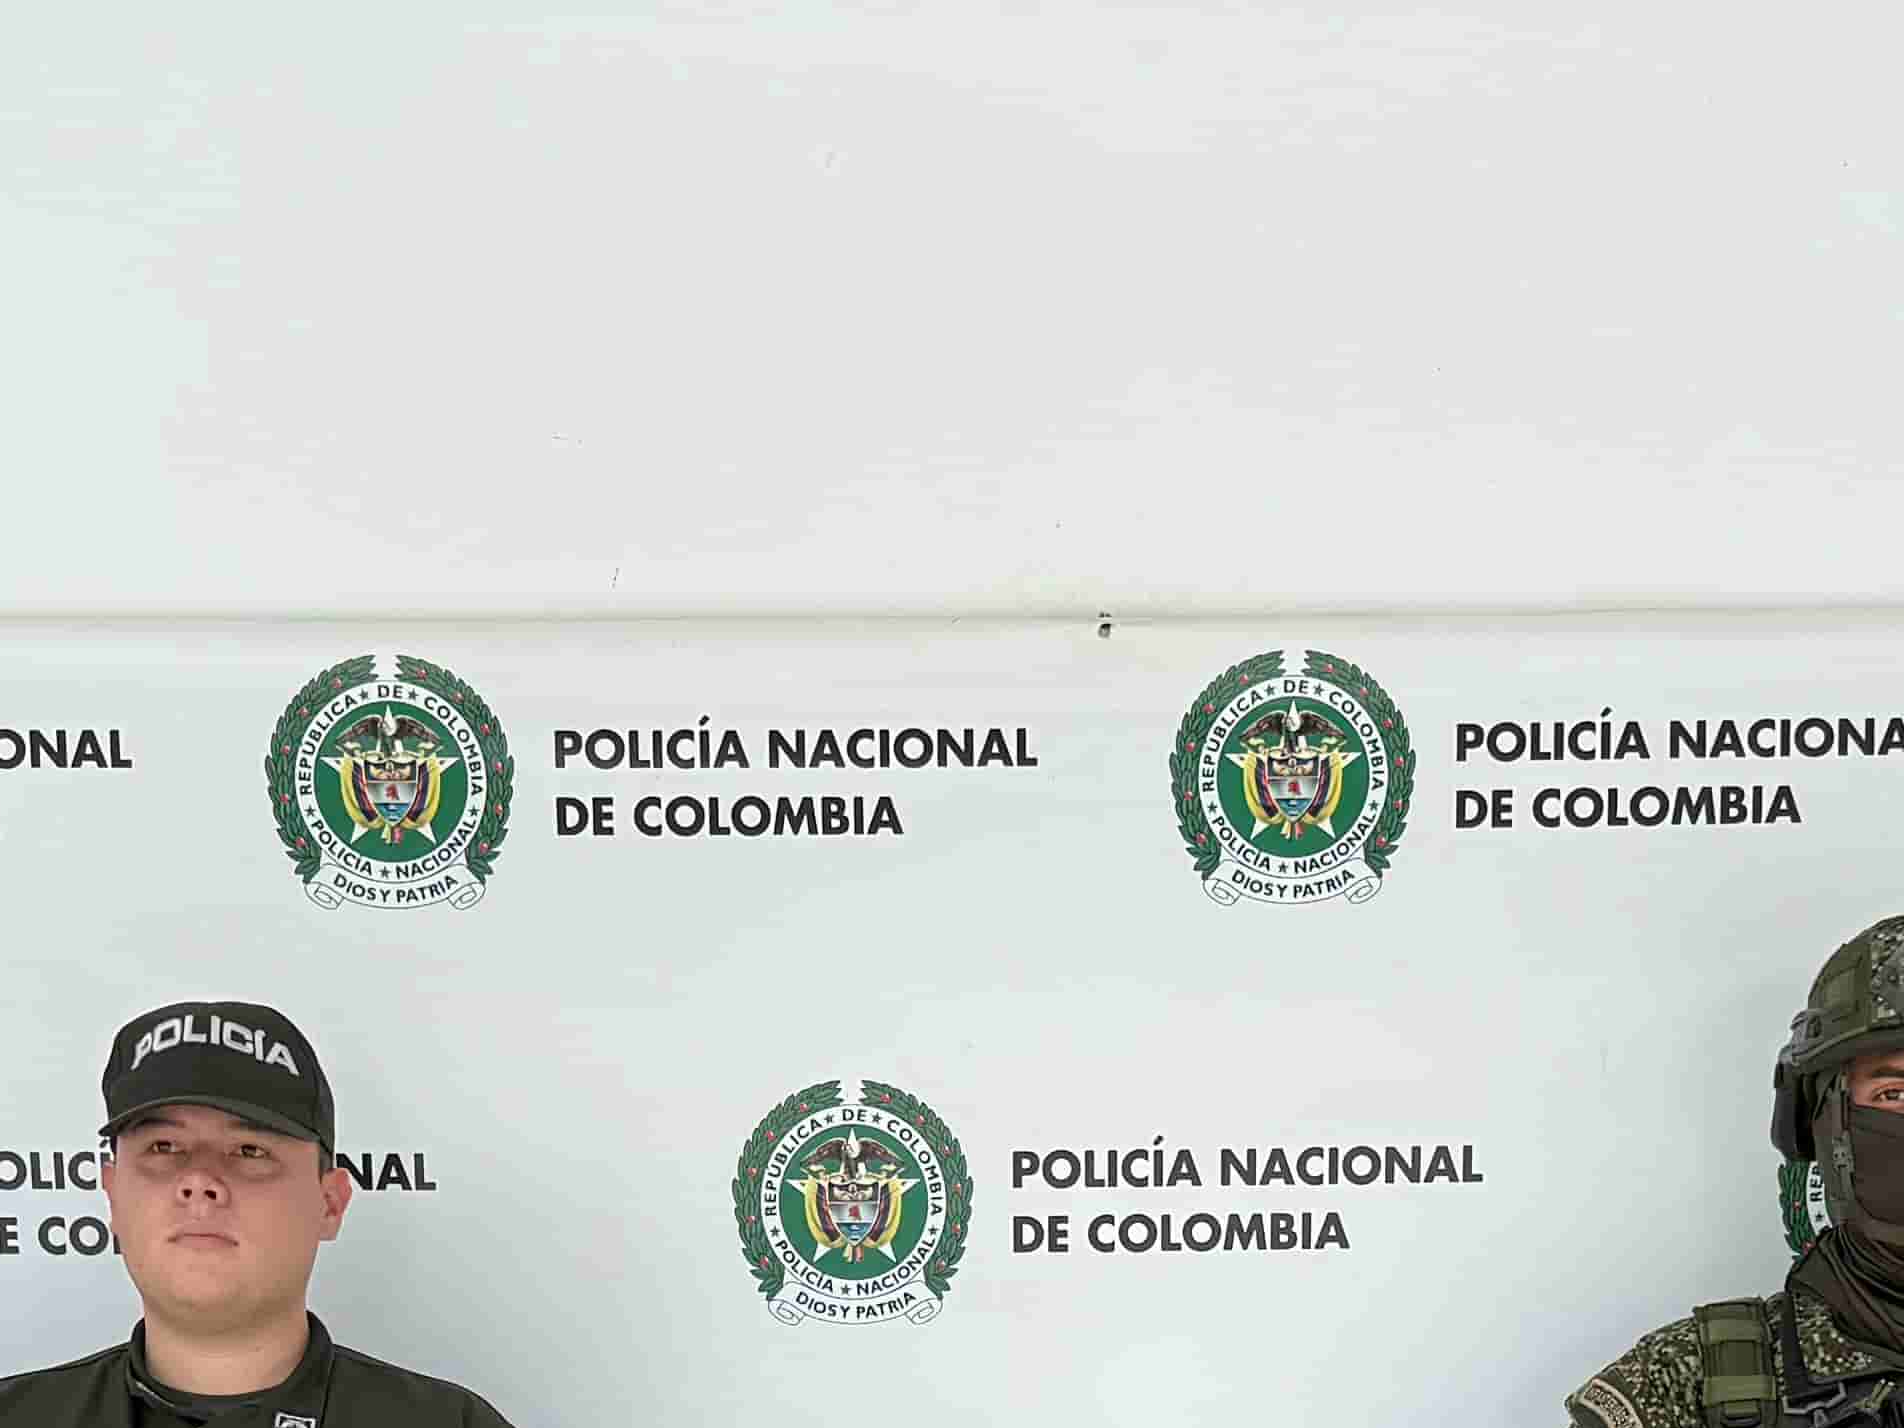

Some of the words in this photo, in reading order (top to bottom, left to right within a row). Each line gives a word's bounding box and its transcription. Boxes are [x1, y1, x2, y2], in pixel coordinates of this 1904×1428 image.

[554, 715, 750, 770] POLICÍA
[768, 727, 1038, 769] NACIONAL
[1455, 706, 1651, 763] POLICÍA
[555, 796, 615, 836] DE
[633, 795, 905, 837] COLOMBIA
[1455, 789, 1513, 829] DE
[1532, 785, 1802, 828] COLOMBIA
[129, 1015, 300, 1075] POLICÍA
[1012, 1135, 1203, 1189] POLICÍA
[1220, 1144, 1484, 1187] NACIONAL
[1012, 1215, 1069, 1254] DE
[1087, 1212, 1350, 1253] COLOMBIA
